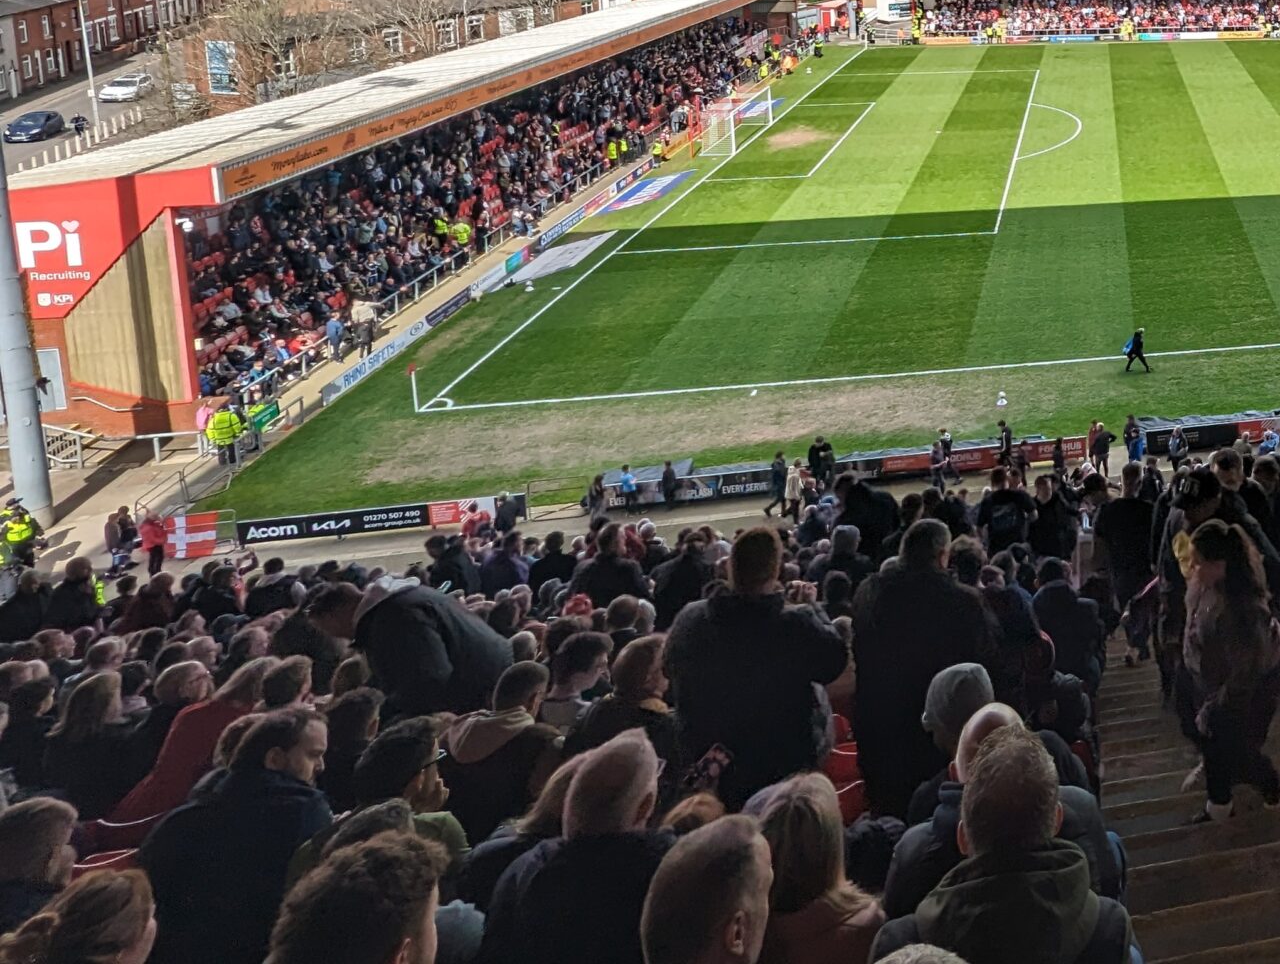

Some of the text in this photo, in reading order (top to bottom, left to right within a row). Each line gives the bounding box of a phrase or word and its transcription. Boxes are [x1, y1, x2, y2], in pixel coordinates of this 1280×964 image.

[15, 220, 83, 269] Pi
[30, 271, 91, 282] Recruiting
[343, 341, 396, 388] RHINO SAFETY
[722, 485, 745, 495] EVERY
[363, 510, 421, 522] 01270 507 490
[364, 518, 421, 529] acorn-group.co.uk
[246, 523, 299, 540] Acorn
